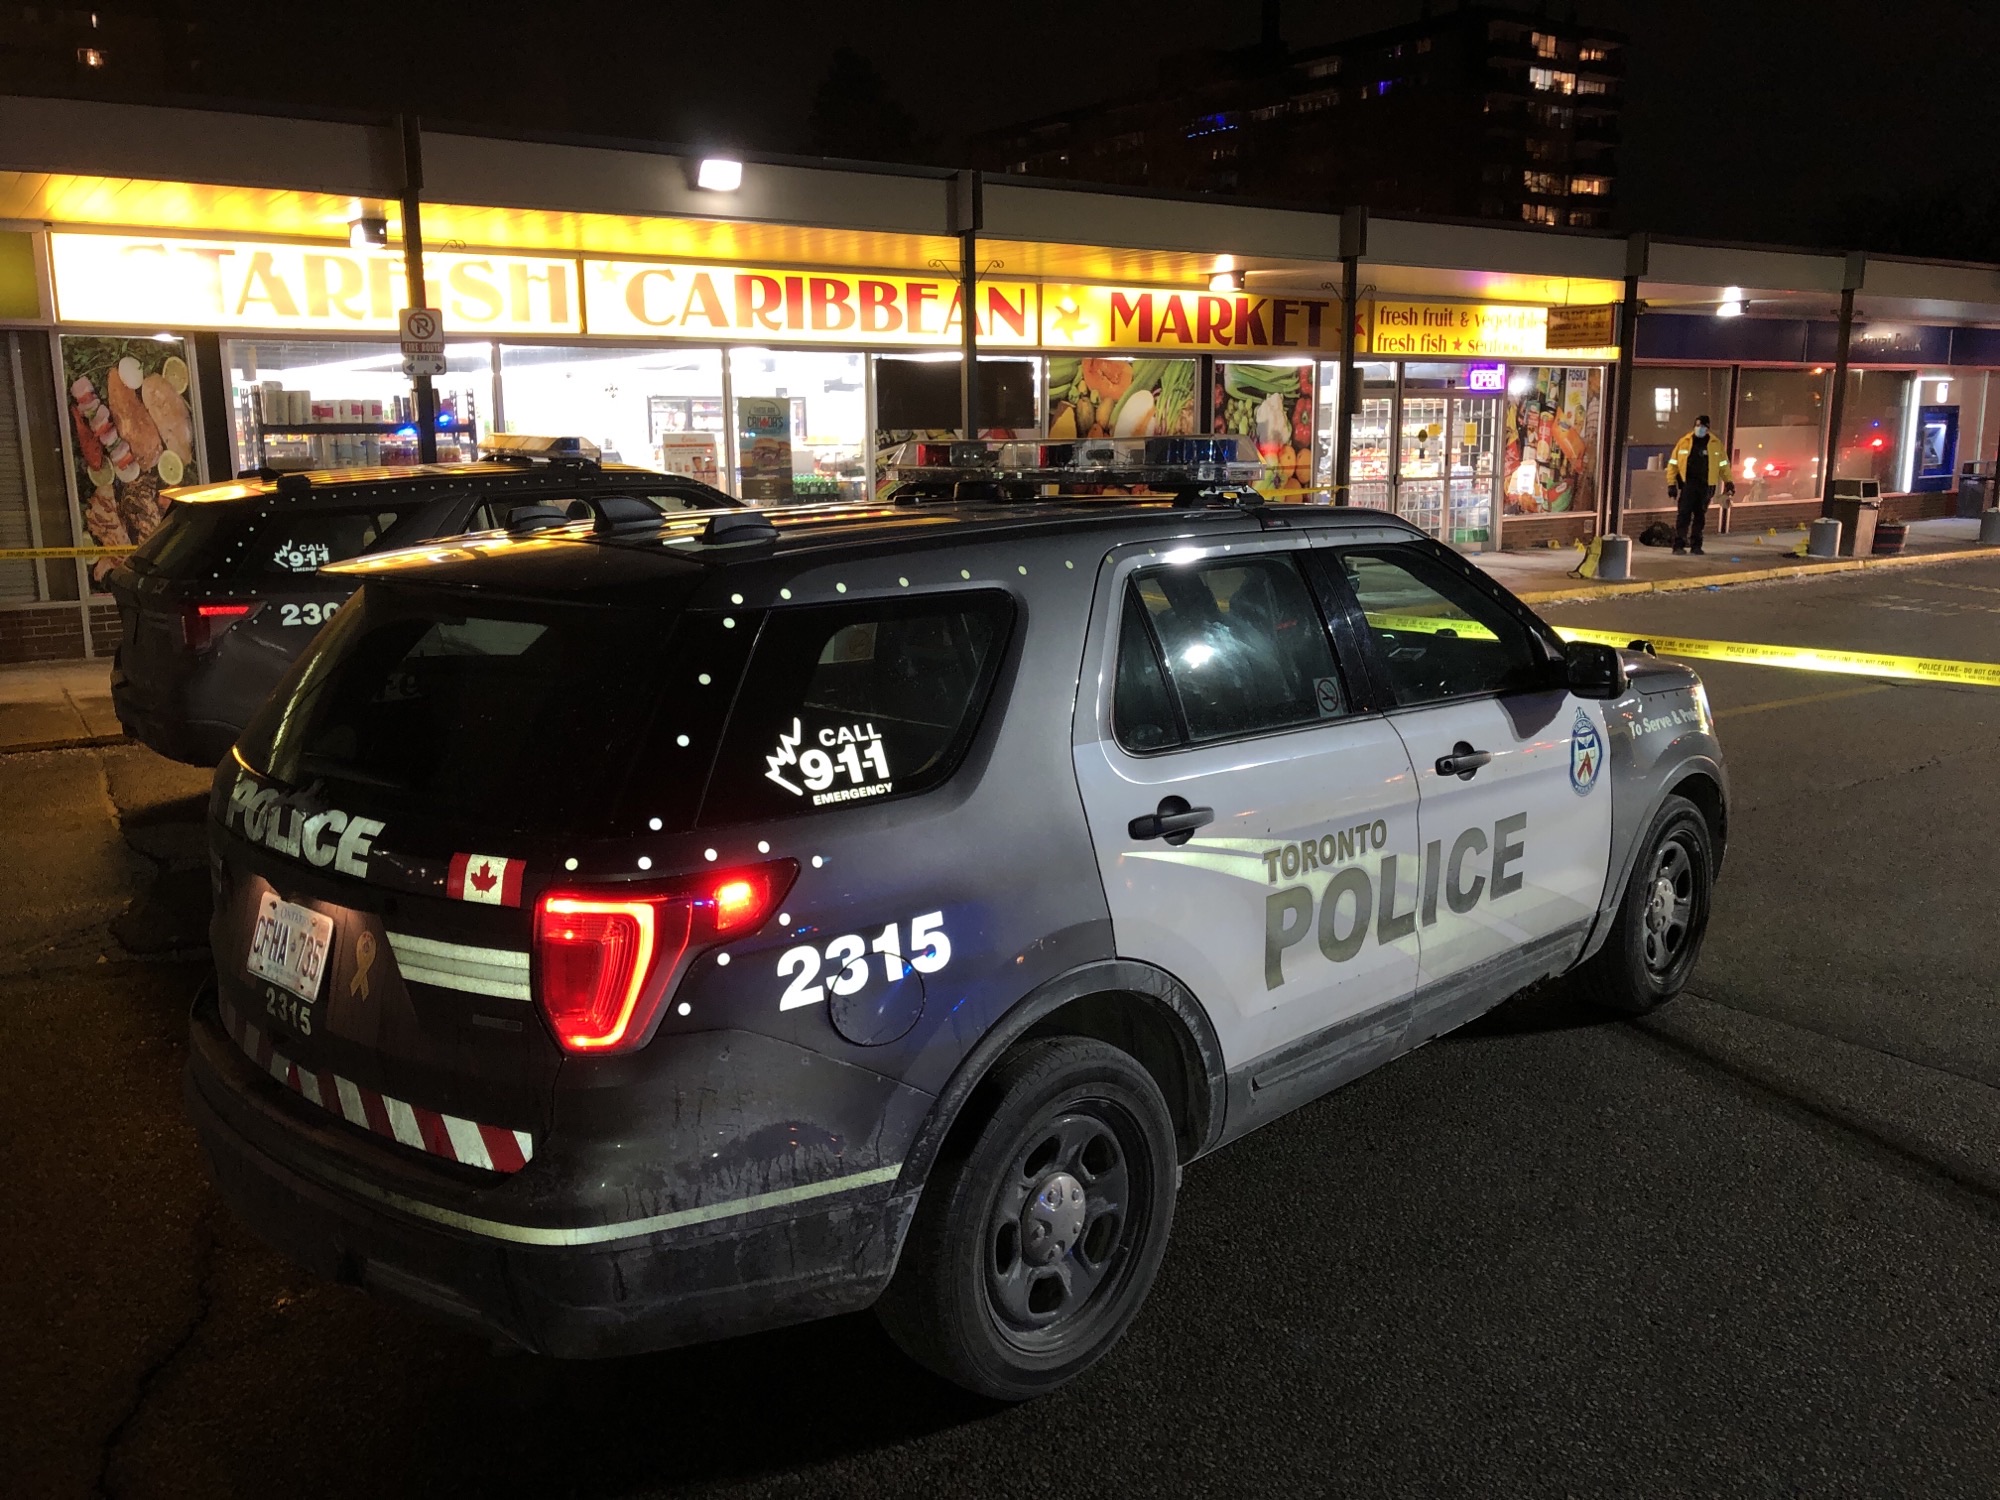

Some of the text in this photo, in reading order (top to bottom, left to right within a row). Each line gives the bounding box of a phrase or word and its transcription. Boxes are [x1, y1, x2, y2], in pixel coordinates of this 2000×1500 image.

[625, 269, 1026, 337] CARIBBEAN
[1110, 292, 1330, 348] MARKET
[1380, 306, 1418, 327] fresh
[1423, 307, 1454, 327] fruit
[1460, 312, 1469, 328] &
[405, 343, 441, 352] FIRE ROUTE
[1377, 333, 1415, 352] fresh
[1421, 334, 1447, 353] fish
[1472, 373, 1500, 389] OPEN
[288, 550, 330, 567] 9-1-1
[299, 543, 329, 552] CALL
[1726, 646, 1745, 654] POLICE
[1918, 662, 1942, 671] POLICE
[818, 722, 882, 747] CALL
[1628, 720, 1643, 740] To
[1642, 716, 1673, 733] Serve
[1671, 710, 1682, 725] &
[799, 739, 890, 791] 9-1-1
[812, 782, 893, 806] EMERGENCY
[225, 778, 386, 879] POLICE
[1263, 818, 1387, 884] TORONTO
[1264, 811, 1527, 991] POLICE
[777, 910, 952, 1012] 2315
[266, 986, 312, 1036] 2315
